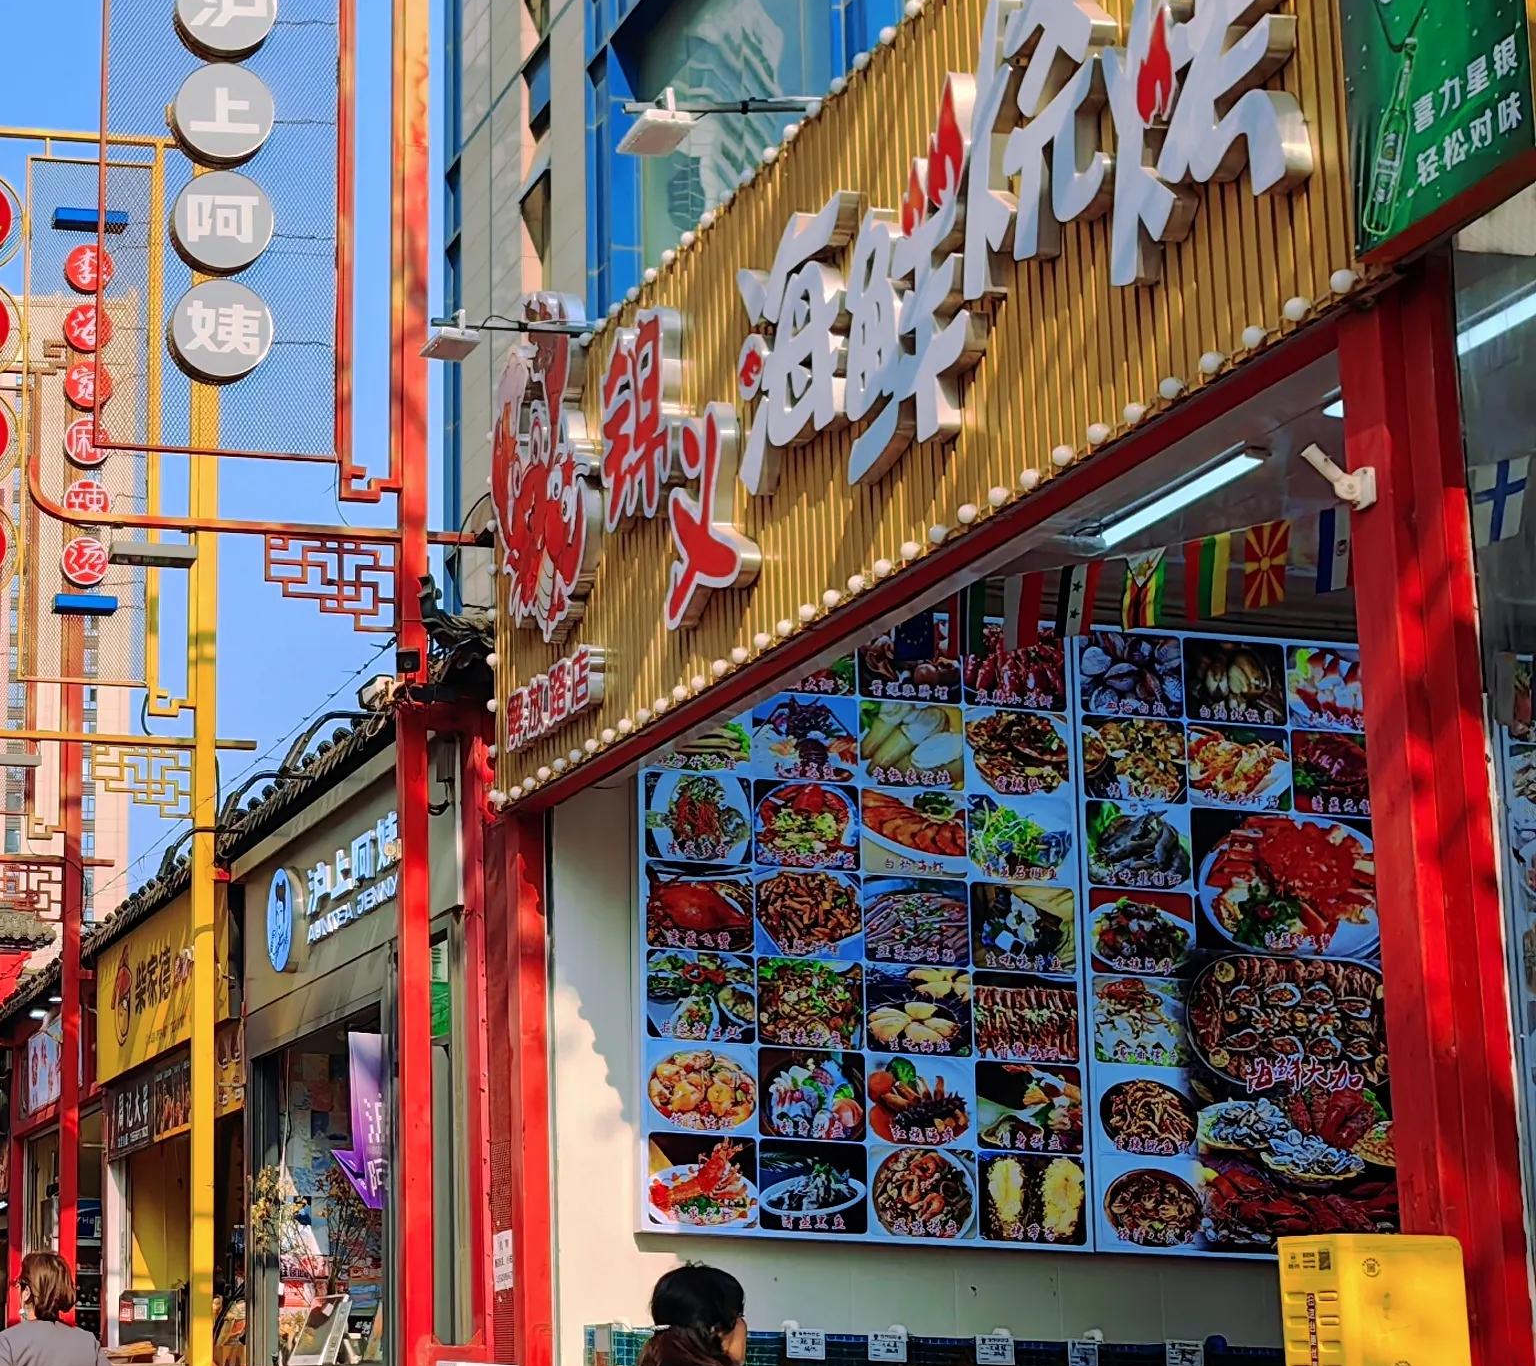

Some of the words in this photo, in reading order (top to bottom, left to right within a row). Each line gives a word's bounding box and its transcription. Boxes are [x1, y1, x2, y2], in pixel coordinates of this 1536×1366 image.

[1412, 35, 1519, 134] 喜力星银
[1415, 92, 1524, 187] 轻松对味
